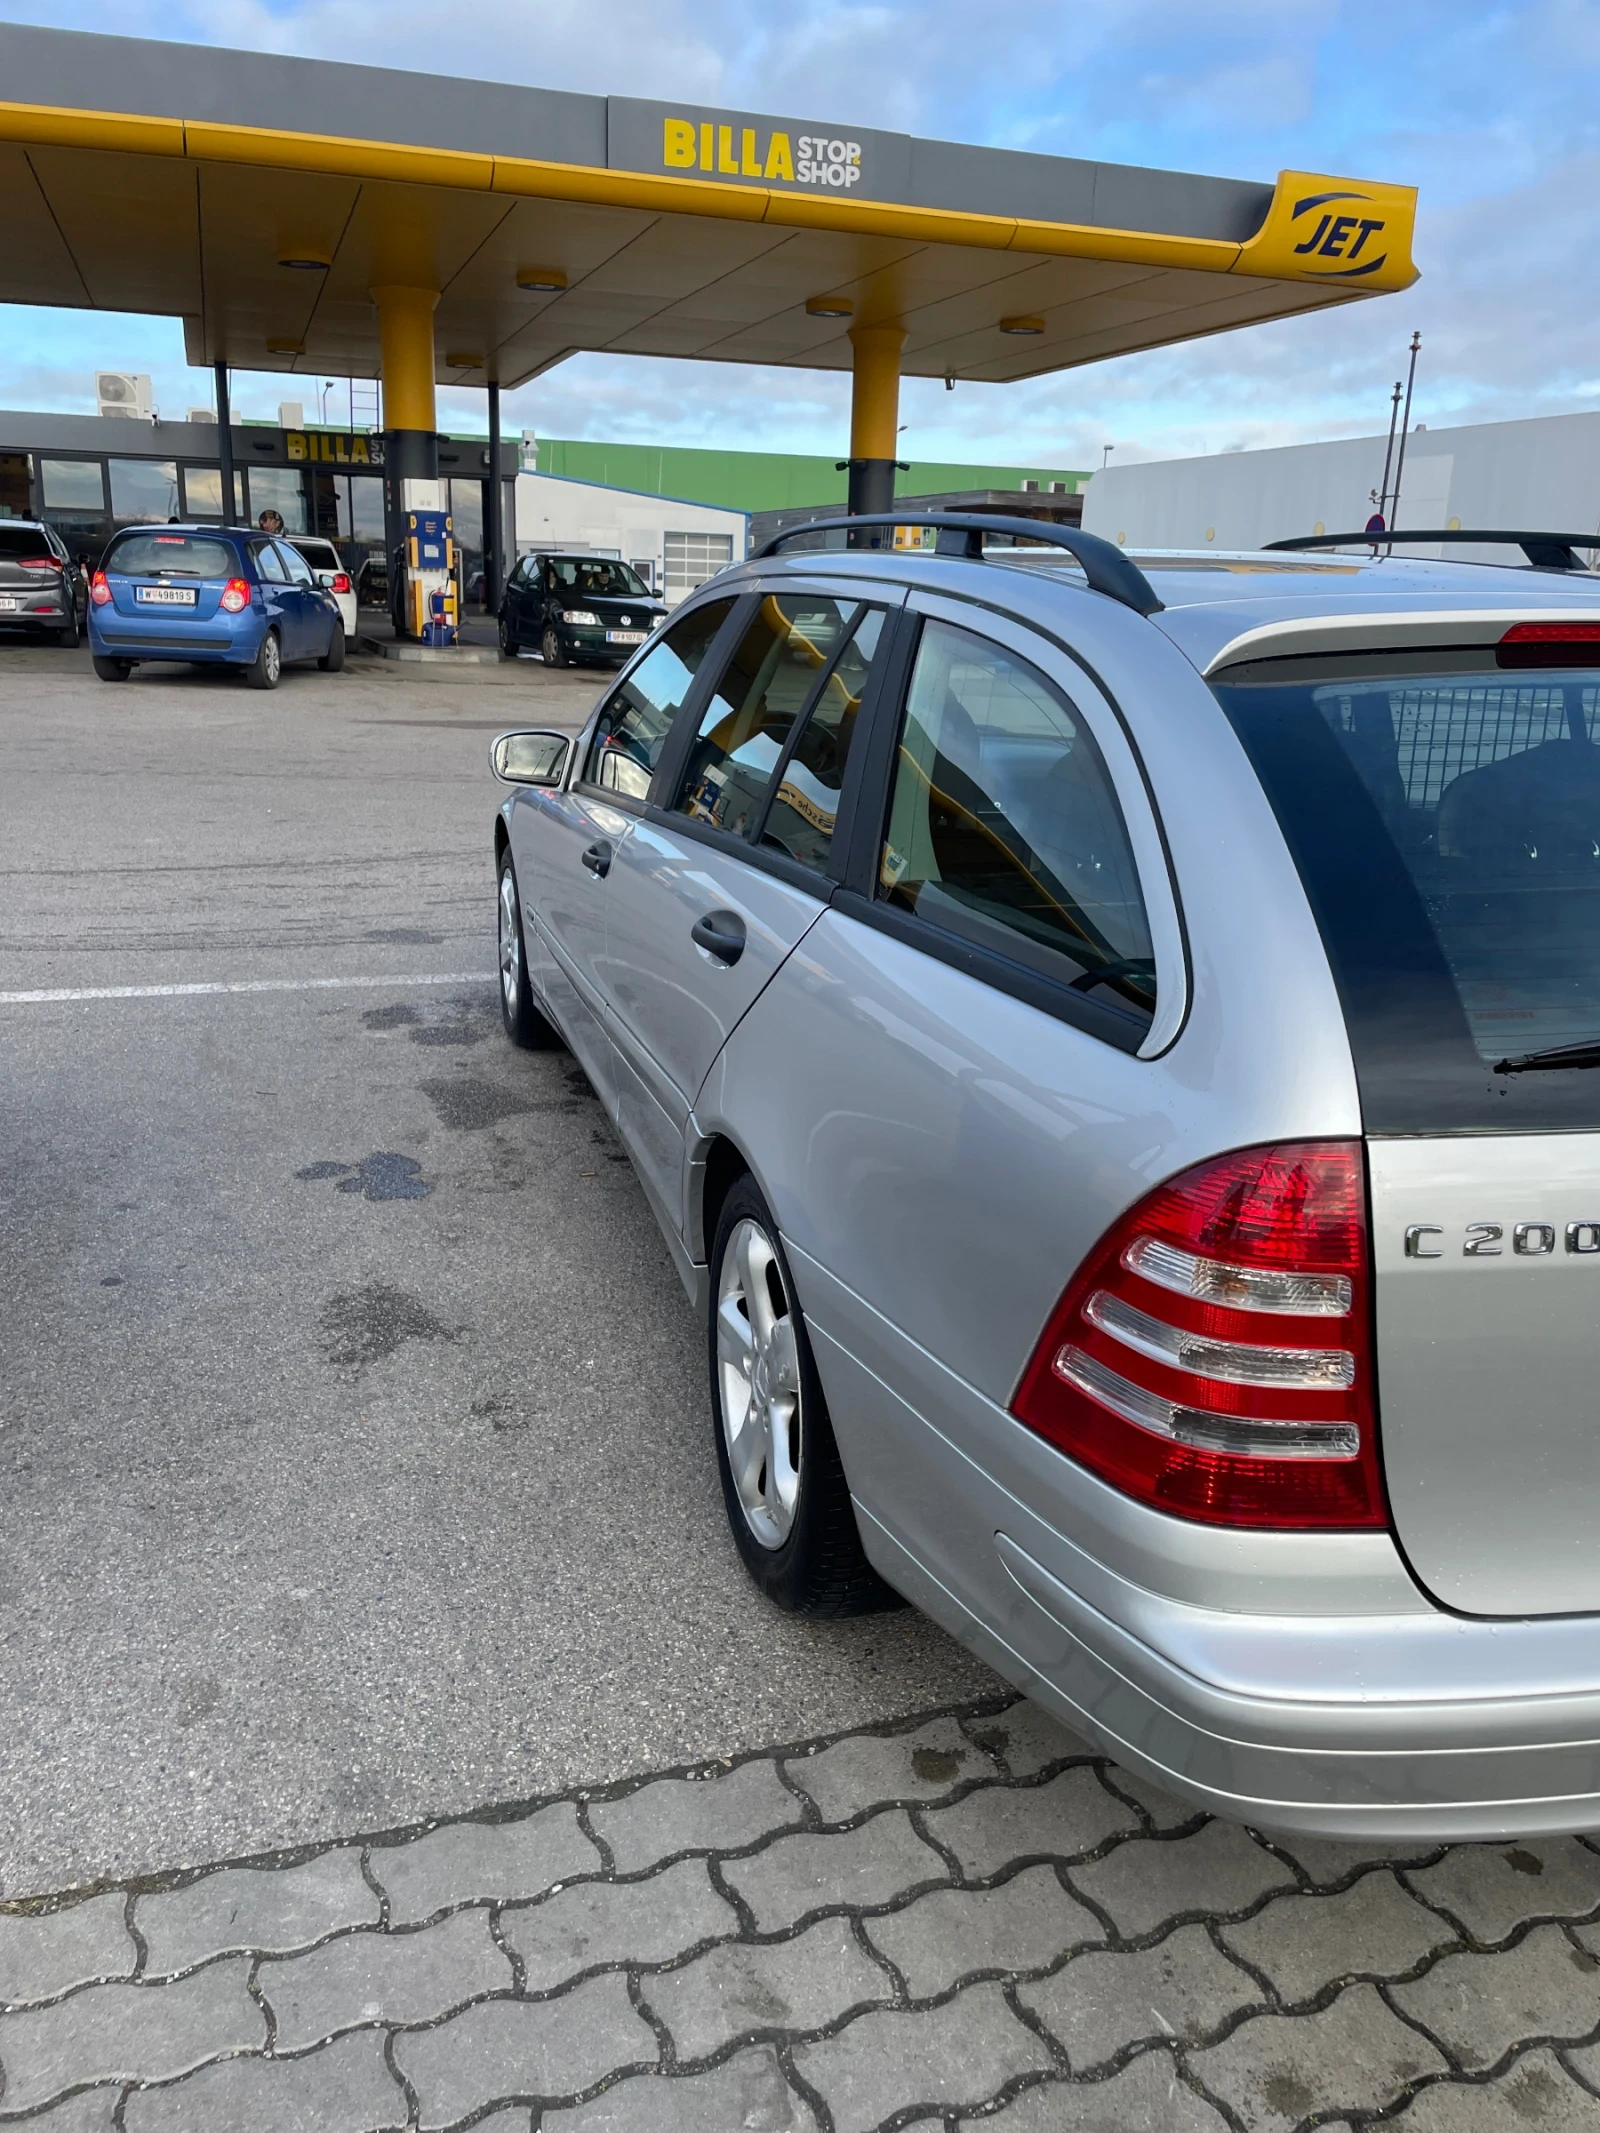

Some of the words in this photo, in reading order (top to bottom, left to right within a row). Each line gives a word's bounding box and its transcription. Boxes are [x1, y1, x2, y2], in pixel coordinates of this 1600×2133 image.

[664, 118, 795, 181] BILLA
[797, 136, 861, 165] STOP
[796, 160, 861, 188] SHOP
[1293, 214, 1385, 259] JET
[287, 433, 370, 463] BILLA
[370, 439, 385, 452] ST
[1404, 1223, 1443, 1259] C
[1463, 1220, 1600, 1257] 200
